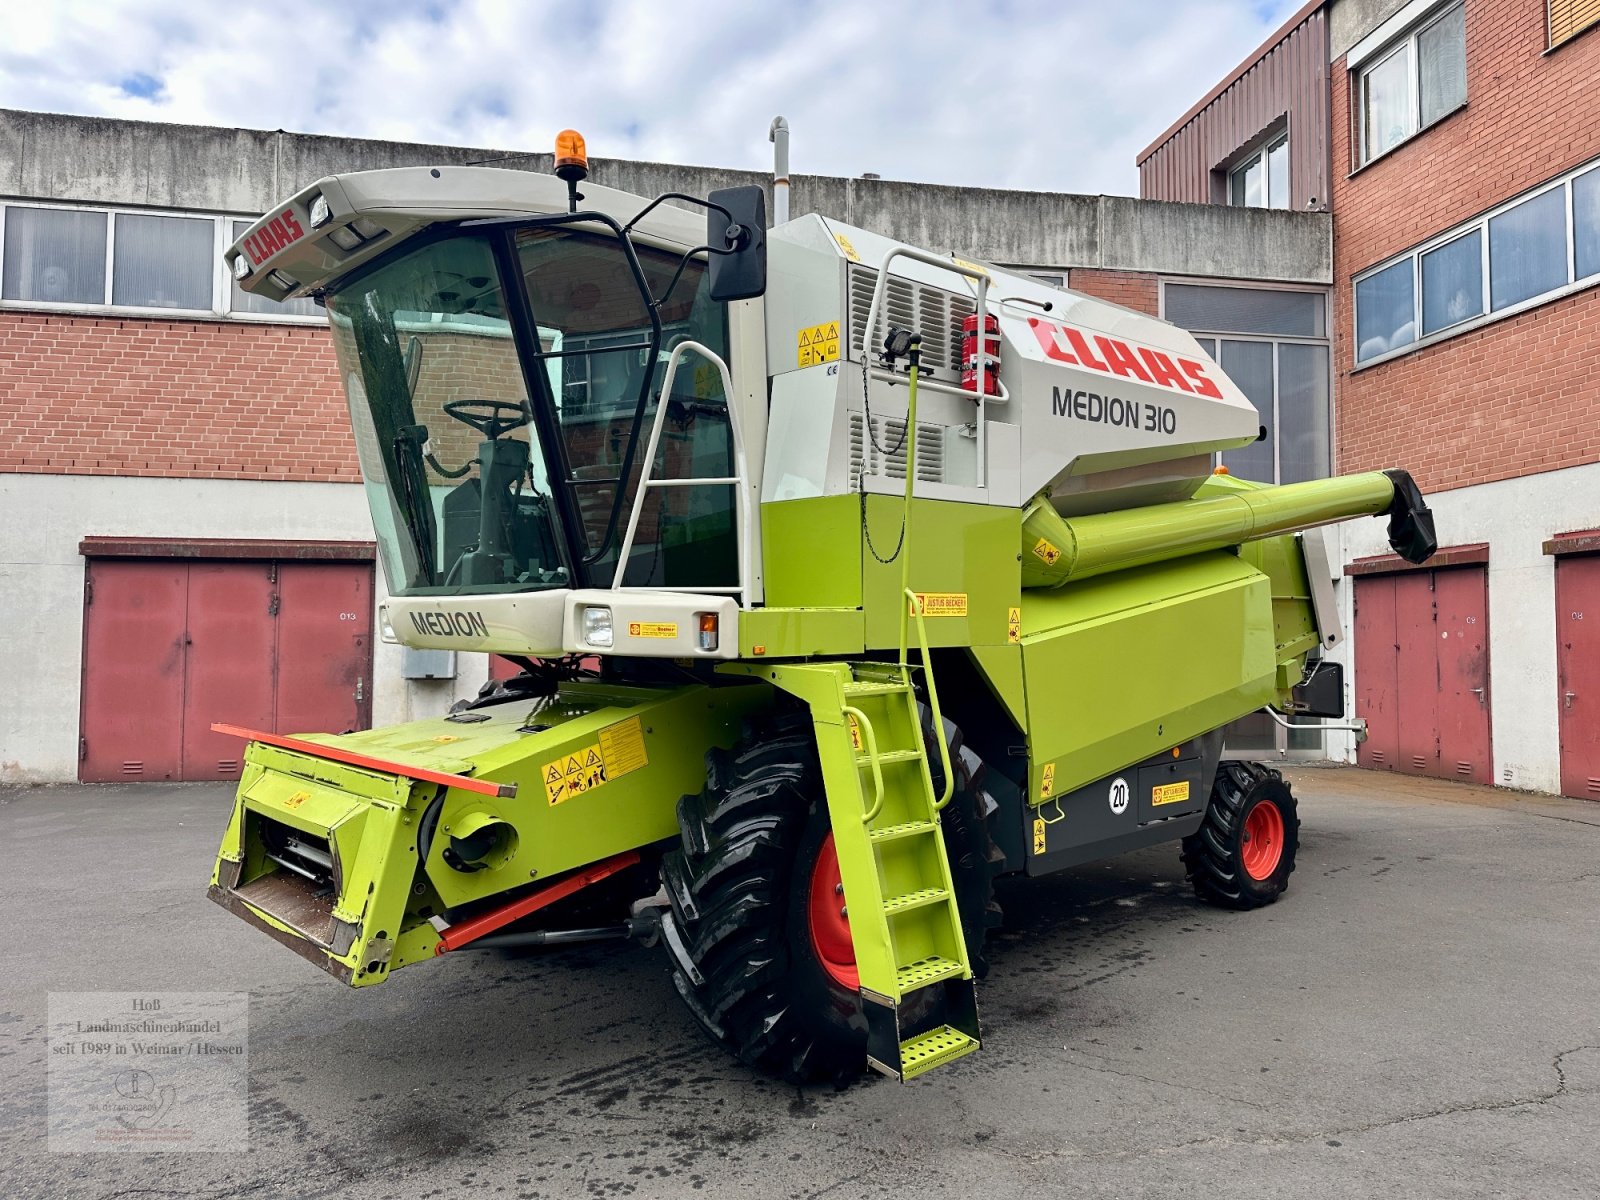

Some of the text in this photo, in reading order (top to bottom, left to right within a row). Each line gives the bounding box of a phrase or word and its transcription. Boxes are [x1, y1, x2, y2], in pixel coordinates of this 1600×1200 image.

[243, 208, 305, 266] CLAAS
[1027, 317, 1224, 400] CLAAS
[1052, 386, 1176, 435] MEDION 310
[339, 613, 357, 621] 013
[409, 611, 490, 637] MEDION
[1113, 784, 1125, 808] 20
